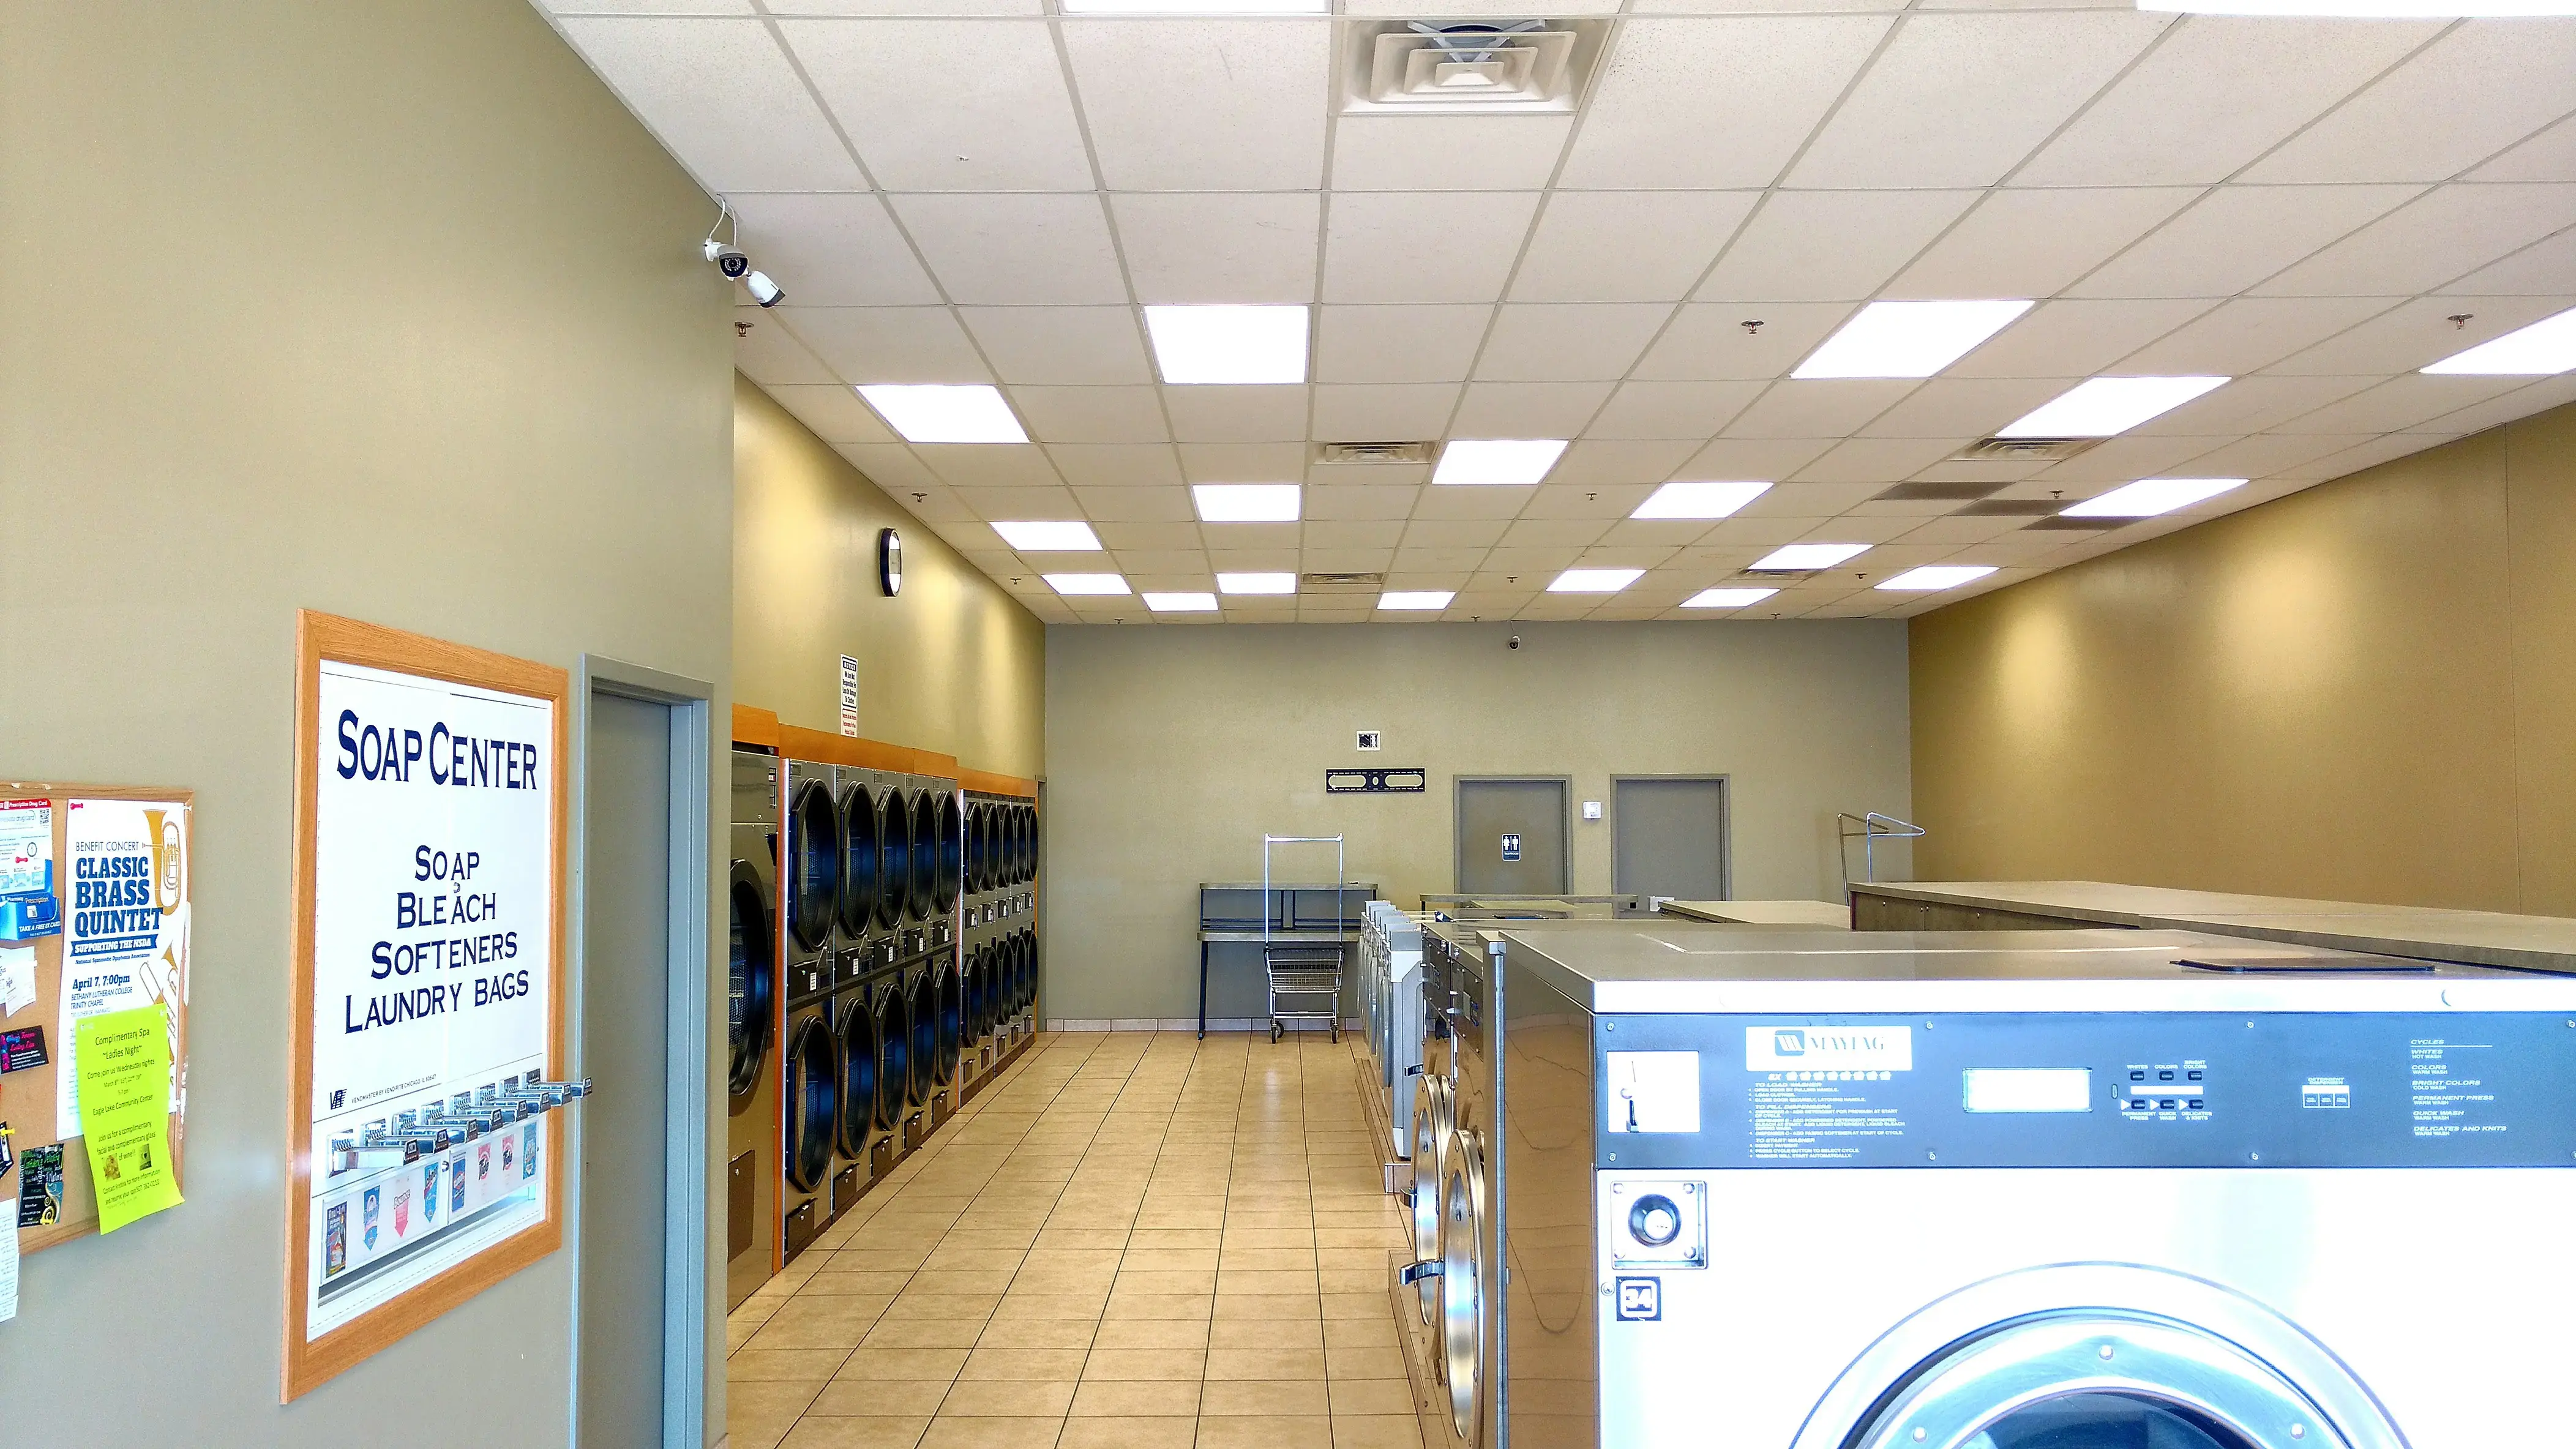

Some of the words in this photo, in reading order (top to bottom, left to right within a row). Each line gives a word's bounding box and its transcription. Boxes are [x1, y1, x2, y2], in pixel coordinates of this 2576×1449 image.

[337, 709, 422, 782] SOAP
[429, 721, 537, 790] CENTER
[76, 842, 103, 852] BENEFIT
[107, 841, 140, 851] CONCERT
[76, 856, 148, 879] CLASSIC
[415, 845, 479, 882] SOAP
[75, 879, 149, 908] BRASS
[397, 892, 496, 929] BLEACH
[75, 907, 163, 937] QUINTET
[75, 941, 119, 953] SUPPORTING
[119, 940, 133, 949] THE
[133, 938, 151, 948] NSDA
[371, 932, 517, 979] SOFTENERS
[71, 992, 92, 1001] BETHANY
[92, 989, 114, 998] LUTHERAN
[115, 986, 132, 995] COLLEGE
[72, 977, 92, 991] April
[94, 976, 100, 987] 7,
[103, 975, 130, 986] 7:00pm
[71, 1001, 87, 1009] TRINITY
[88, 999, 103, 1008] CHAPEL
[345, 982, 463, 1034] LAUNDRY
[474, 970, 529, 1007] BAGS
[95, 1031, 138, 1046] Complimentary
[140, 1028, 150, 1038] Spa
[1810, 1036, 1884, 1050] MAYTAG
[116, 1062, 141, 1073] Wednesday
[141, 1059, 154, 1068] nights
[351, 1091, 378, 1103] VENDMASTER
[404, 1079, 421, 1088] CHICAGO
[93, 1107, 104, 1116] Eagle
[116, 1099, 140, 1109] Community
[140, 1095, 153, 1103] Center
[479, 1158, 490, 1180] Tide
[503, 1149, 513, 1171] Tide
[393, 1189, 410, 1210] Bounce
[1626, 1288, 1652, 1308] 34
